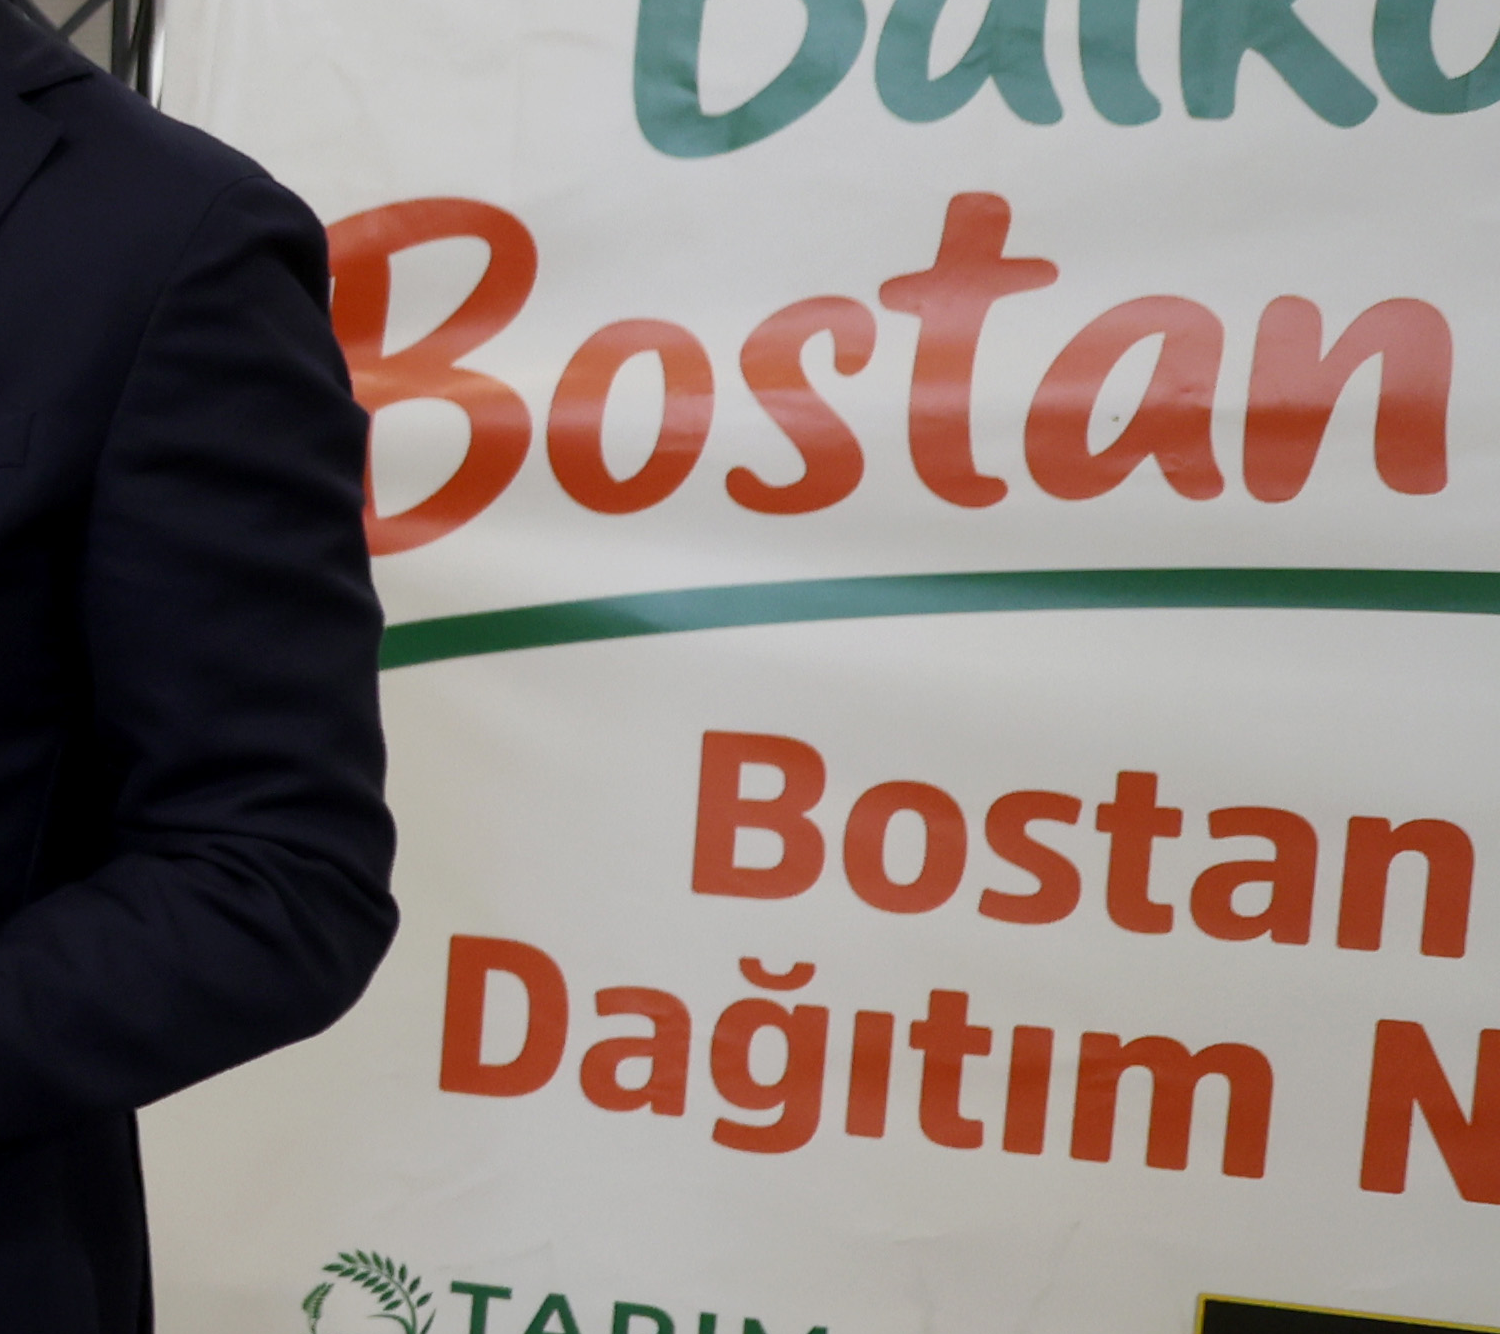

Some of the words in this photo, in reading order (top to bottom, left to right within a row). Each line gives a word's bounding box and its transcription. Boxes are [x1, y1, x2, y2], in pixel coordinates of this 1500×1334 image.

[325, 190, 1454, 557] Bostan
[690, 729, 1476, 960] Bostan
[437, 932, 1276, 1181] Dağıtım
